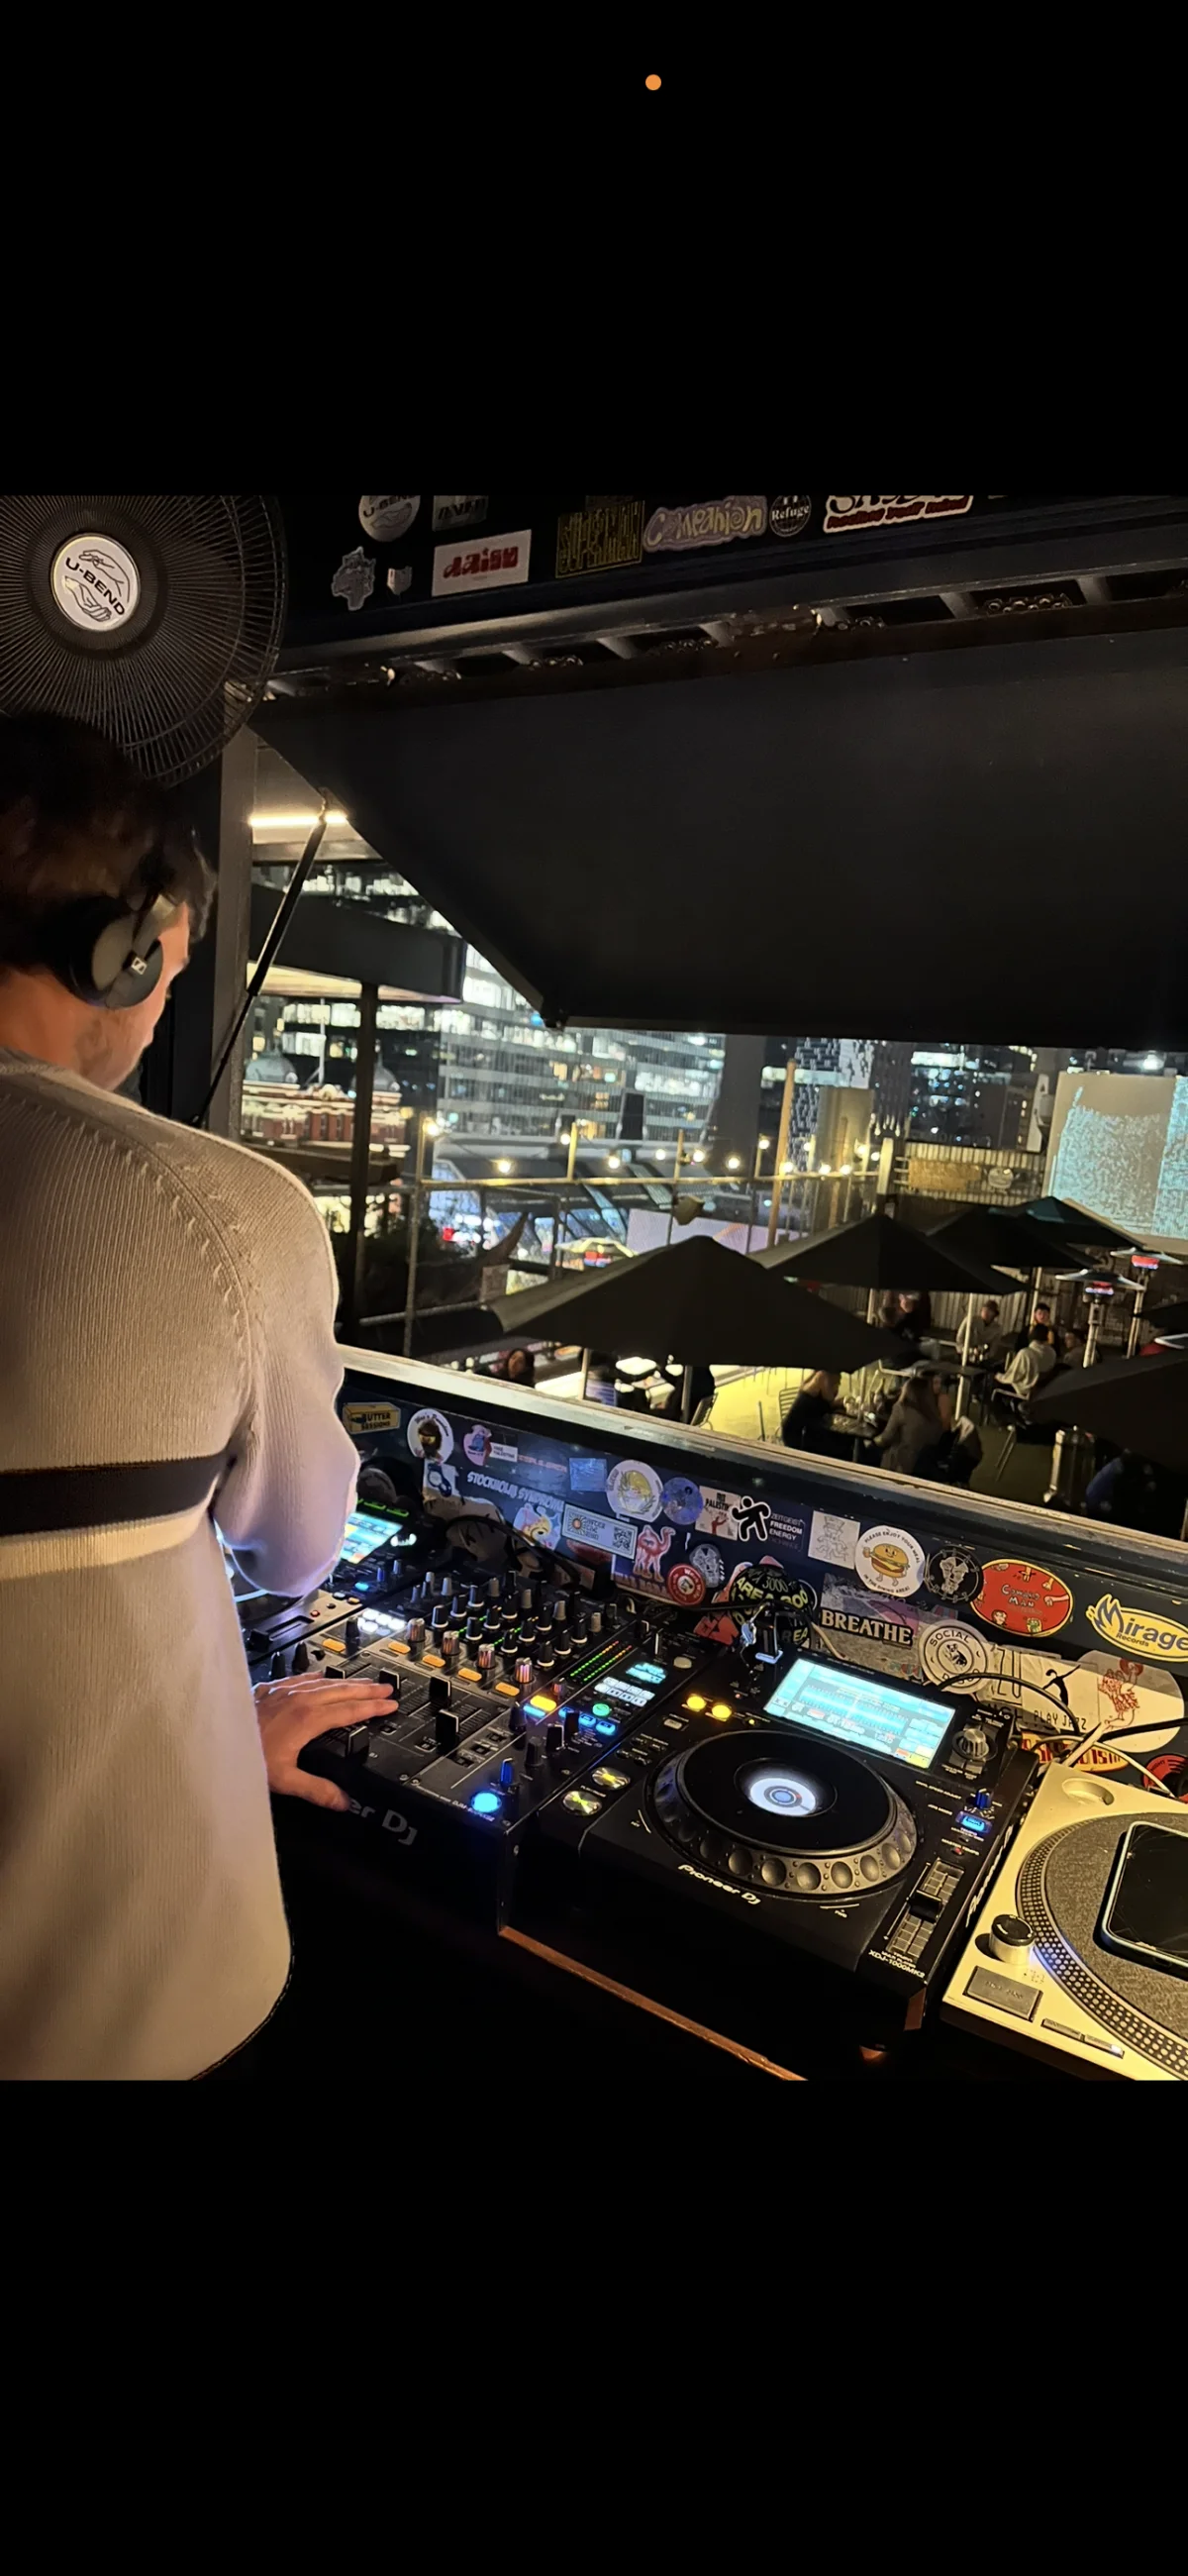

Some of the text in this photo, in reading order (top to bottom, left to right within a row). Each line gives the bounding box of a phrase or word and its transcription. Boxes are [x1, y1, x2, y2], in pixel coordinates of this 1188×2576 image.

[363, 495, 415, 517] U-BEN
[772, 504, 810, 521] Refuge
[65, 558, 125, 615] U-BEND
[706, 1498, 730, 1510] PALESTIN
[768, 1528, 797, 1541] ENERGY
[770, 1520, 803, 1535] FREEDOM
[864, 1531, 882, 1543] PLEASE
[901, 1536, 914, 1550] YOUR
[912, 1549, 921, 1564] MEAL
[761, 1576, 789, 1593] 3000
[821, 1609, 912, 1644] BREATHE
[1096, 1597, 1188, 1651] Mirage
[930, 1629, 969, 1647] SOCIAL
[1116, 1632, 1149, 1647] Records
[1034, 1709, 1058, 1725] PLAY
[382, 1808, 418, 1846] DJ
[678, 1864, 761, 1905] Pioneer DJ
[868, 1949, 926, 1979] XDJ-1000MK2
